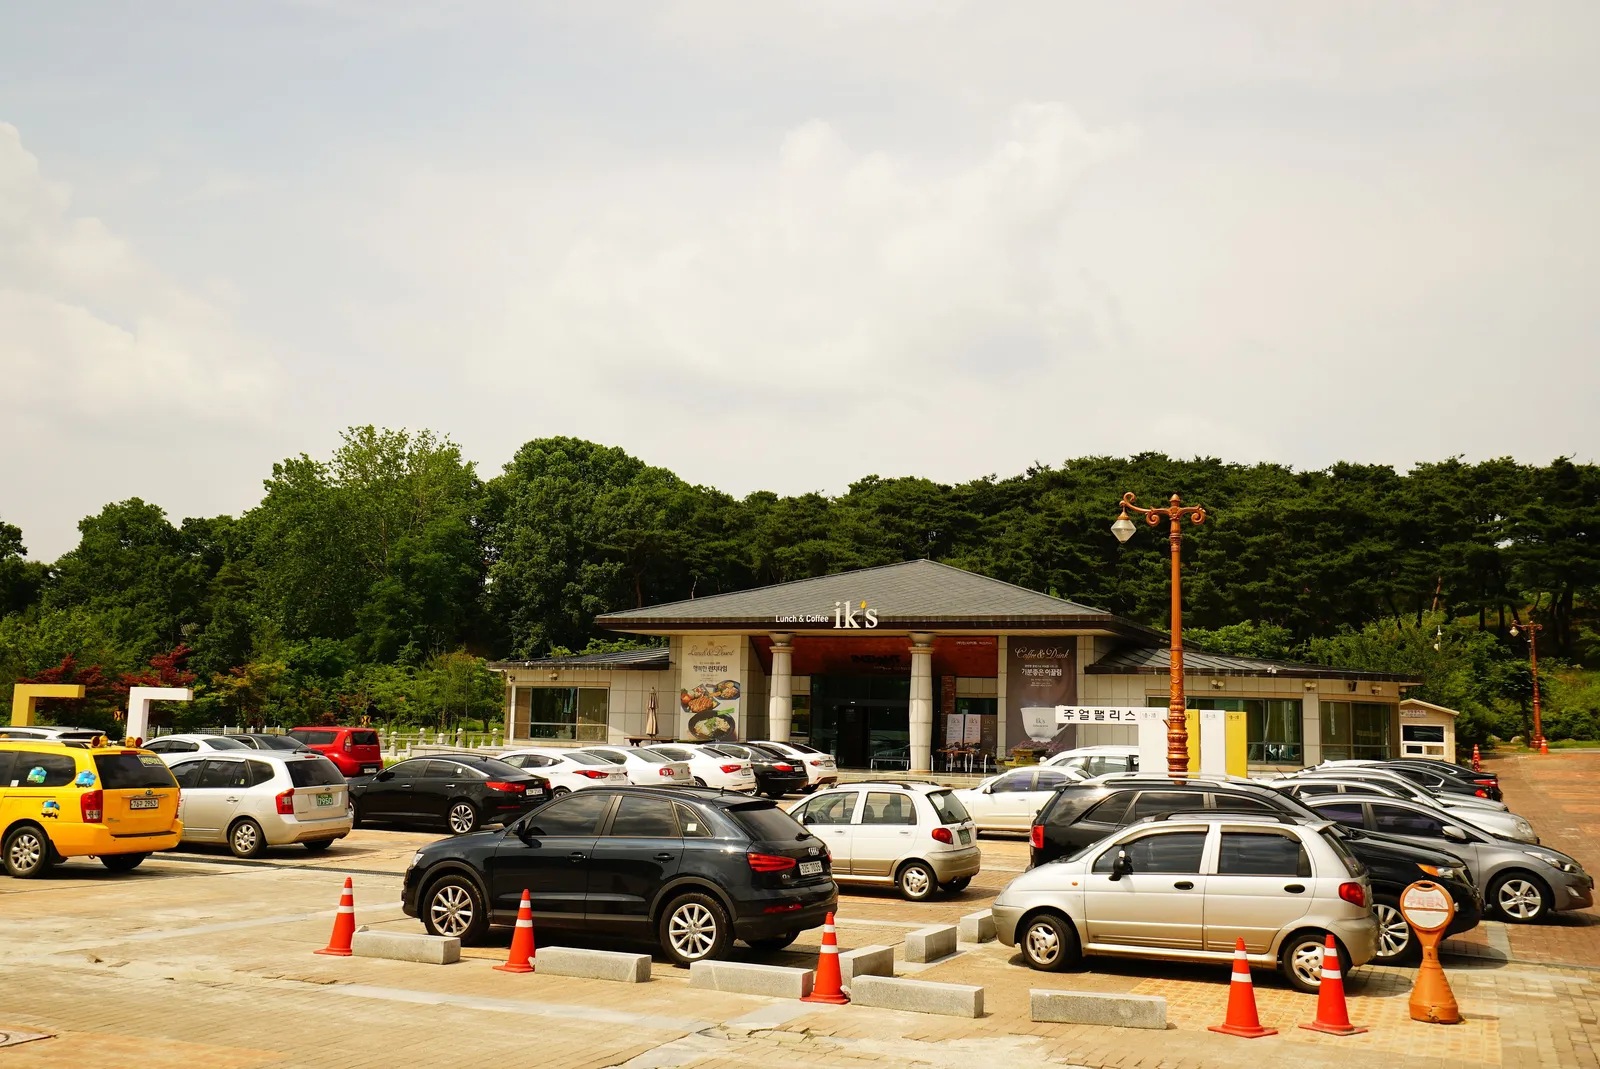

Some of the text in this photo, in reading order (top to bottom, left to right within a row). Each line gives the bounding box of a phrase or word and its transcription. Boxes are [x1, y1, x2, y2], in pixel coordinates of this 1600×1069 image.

[775, 614, 829, 623] Lunch & Coffee
[833, 600, 878, 629] ik's
[1014, 646, 1070, 660] Coffee & Drink
[1063, 708, 1136, 721] 주얼팰리스
[318, 797, 333, 806] 7950
